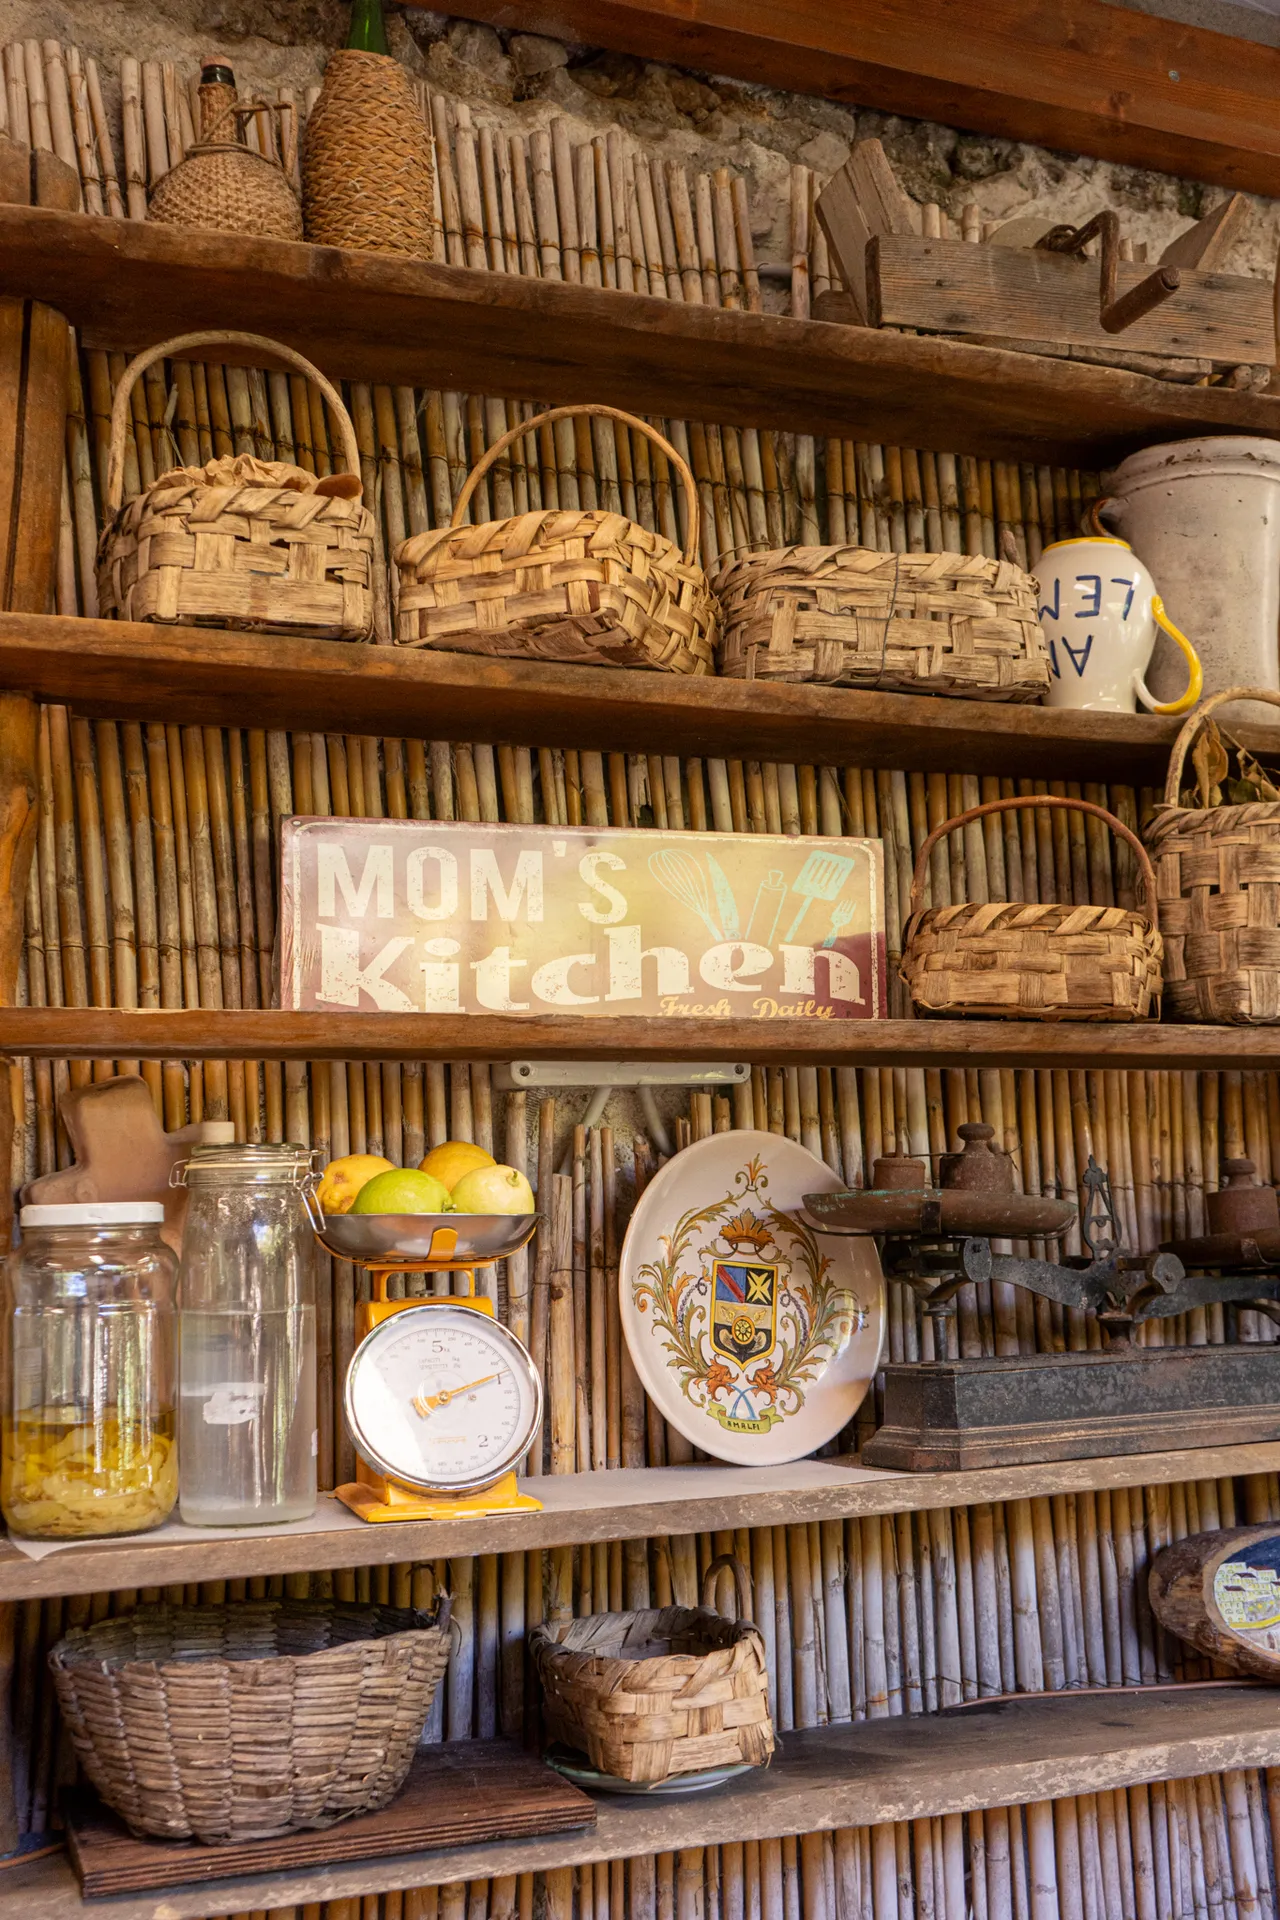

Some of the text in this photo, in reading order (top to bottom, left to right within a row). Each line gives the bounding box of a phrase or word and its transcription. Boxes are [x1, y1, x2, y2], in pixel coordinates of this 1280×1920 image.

[316, 840, 628, 925] MOM'S
[315, 922, 866, 1013] Kitchen
[657, 996, 836, 1020] Fresh Daily
[431, 1340, 443, 1353] 5
[727, 1420, 760, 1430] AMALFI
[477, 1434, 489, 1448] 2
